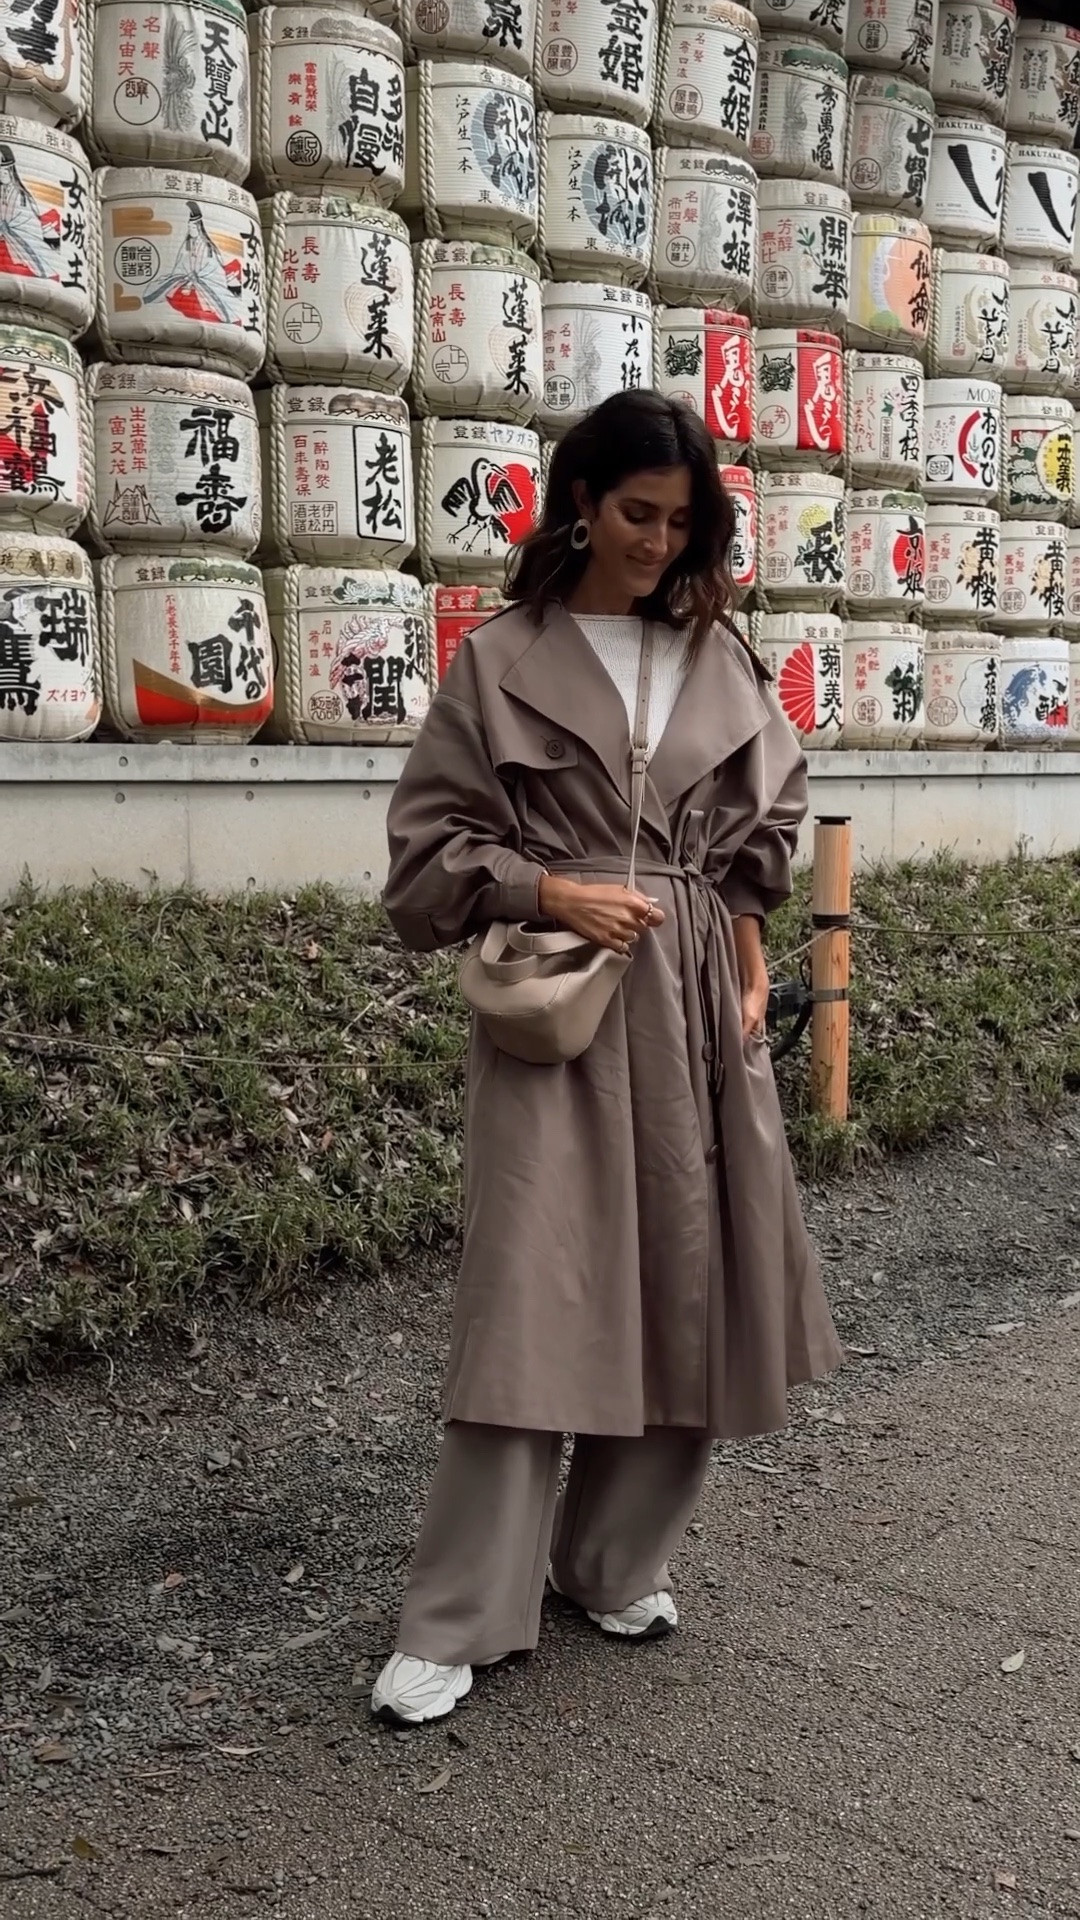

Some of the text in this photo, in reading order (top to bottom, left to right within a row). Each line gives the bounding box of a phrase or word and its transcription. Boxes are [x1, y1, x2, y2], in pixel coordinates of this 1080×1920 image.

[938, 121, 984, 132] HAKUTAKE
[1018, 150, 1062, 160] HAKUTAKE
[60, 167, 87, 293] 女城主
[240, 222, 262, 335] 女城主
[282, 249, 298, 299] 比南山
[430, 296, 446, 342] 比南山
[980, 407, 997, 487] ねのひ
[362, 432, 402, 534] 老松
[308, 504, 321, 532] 老松
[322, 504, 335, 532] 伊丹
[46, 689, 87, 702] ズイヨウ
[816, 645, 844, 731] 菊美人
